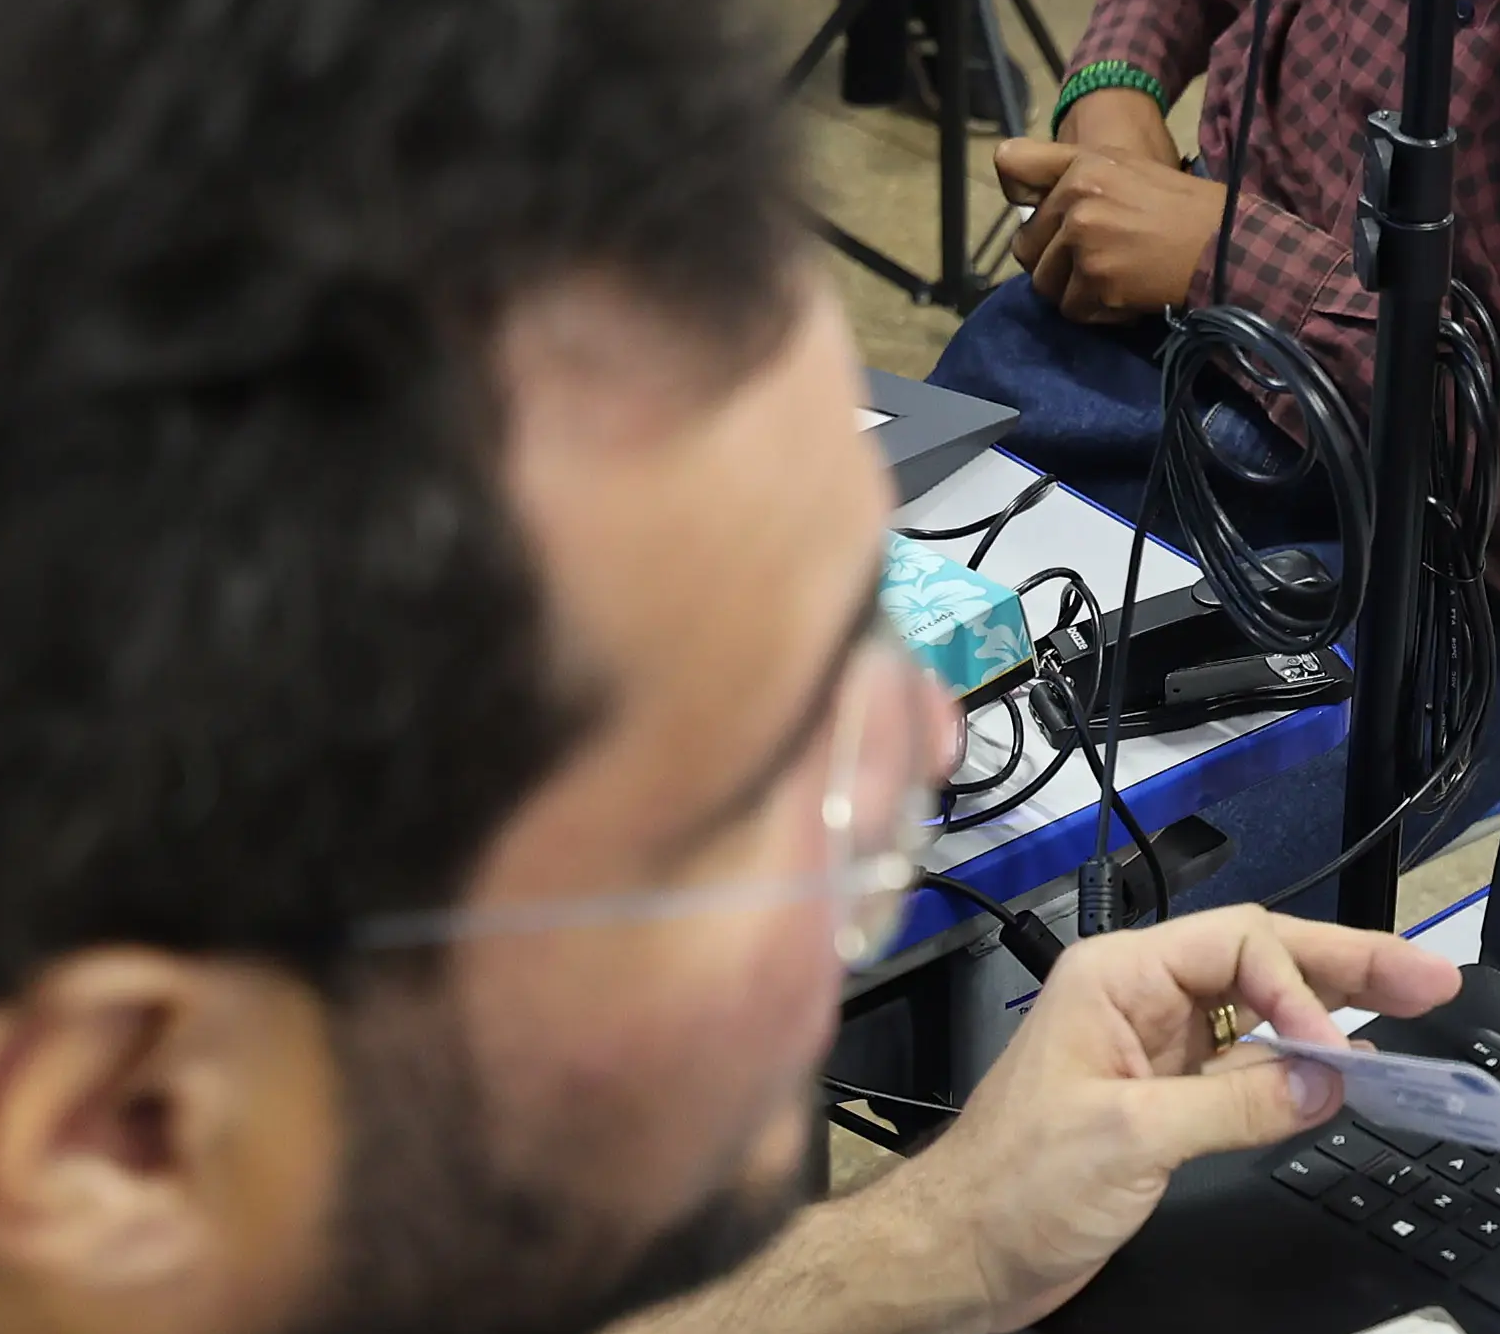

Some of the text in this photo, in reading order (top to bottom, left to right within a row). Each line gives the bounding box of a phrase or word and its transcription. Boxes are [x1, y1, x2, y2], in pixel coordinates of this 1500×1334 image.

[1448, 1158, 1465, 1171] A
[1433, 1195, 1453, 1208] Z
[1479, 1220, 1499, 1234] X
